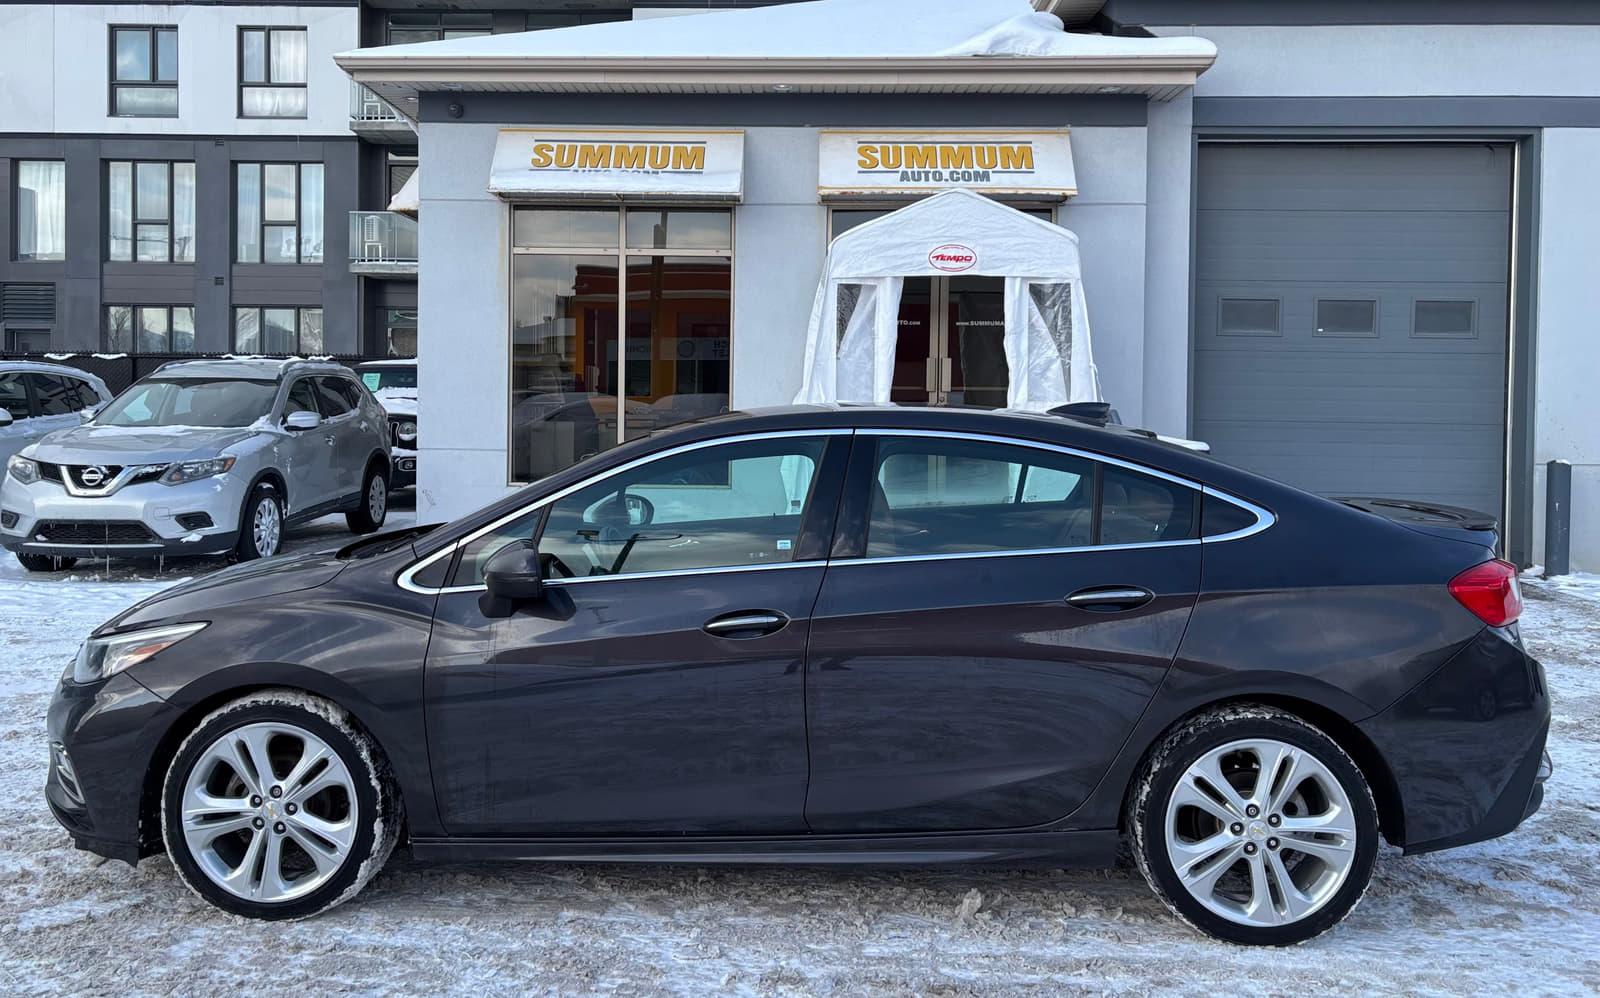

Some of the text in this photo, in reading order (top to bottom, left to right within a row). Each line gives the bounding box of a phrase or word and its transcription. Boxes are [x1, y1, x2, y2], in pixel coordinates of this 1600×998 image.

[531, 143, 706, 169] SUMMUM
[857, 145, 1035, 169] SUMMUM
[900, 170, 991, 182] AUTO.COM
[931, 254, 973, 262] TEMPO
